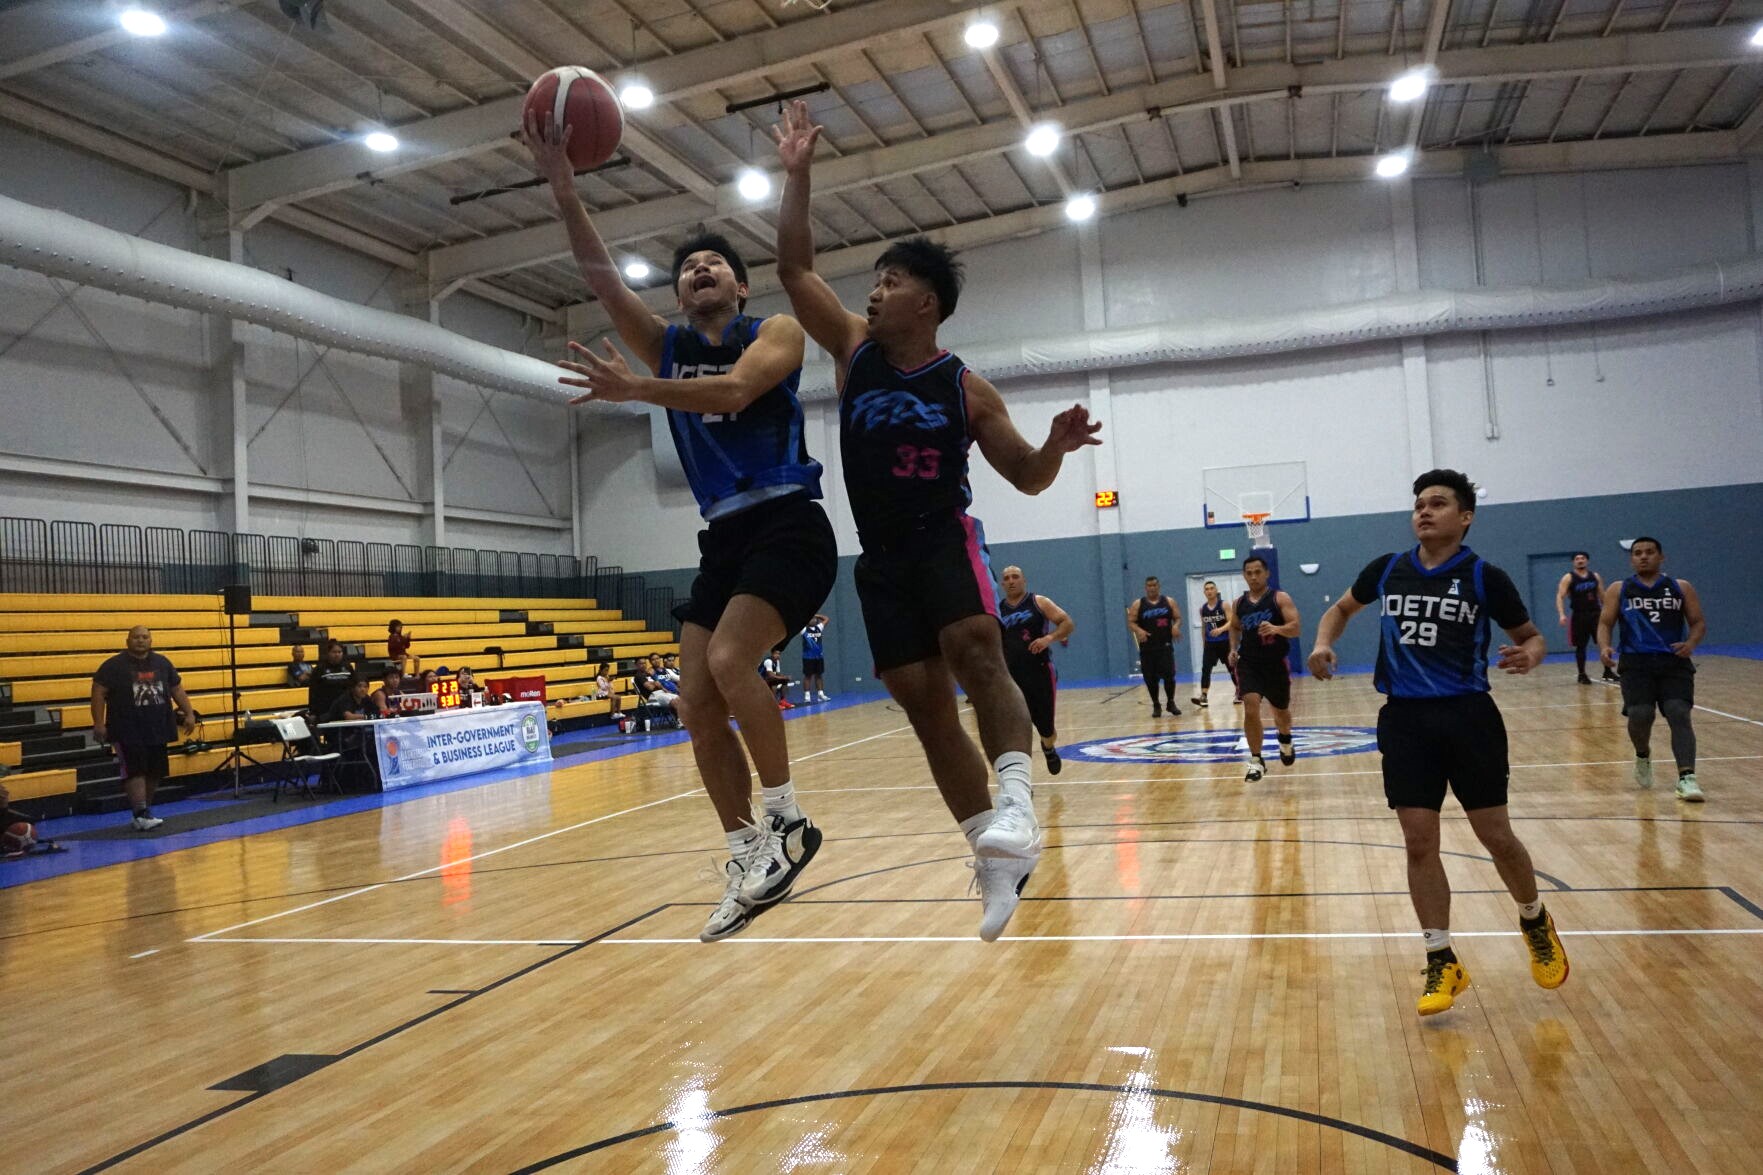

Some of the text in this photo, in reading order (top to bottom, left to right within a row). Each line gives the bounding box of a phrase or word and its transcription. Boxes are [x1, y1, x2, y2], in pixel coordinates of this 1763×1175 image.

[892, 445, 941, 479] 33
[1097, 491, 1113, 506] 22
[1381, 594, 1479, 624] JOETEN
[1625, 597, 1682, 611] JOETEN
[1649, 611, 1661, 623] 2
[1399, 621, 1438, 647] 29
[427, 724, 514, 748] INTER-GOVERNMENT
[433, 753, 440, 765] &
[441, 746, 482, 764] BUSINESS
[484, 740, 516, 756] LEAGUE
